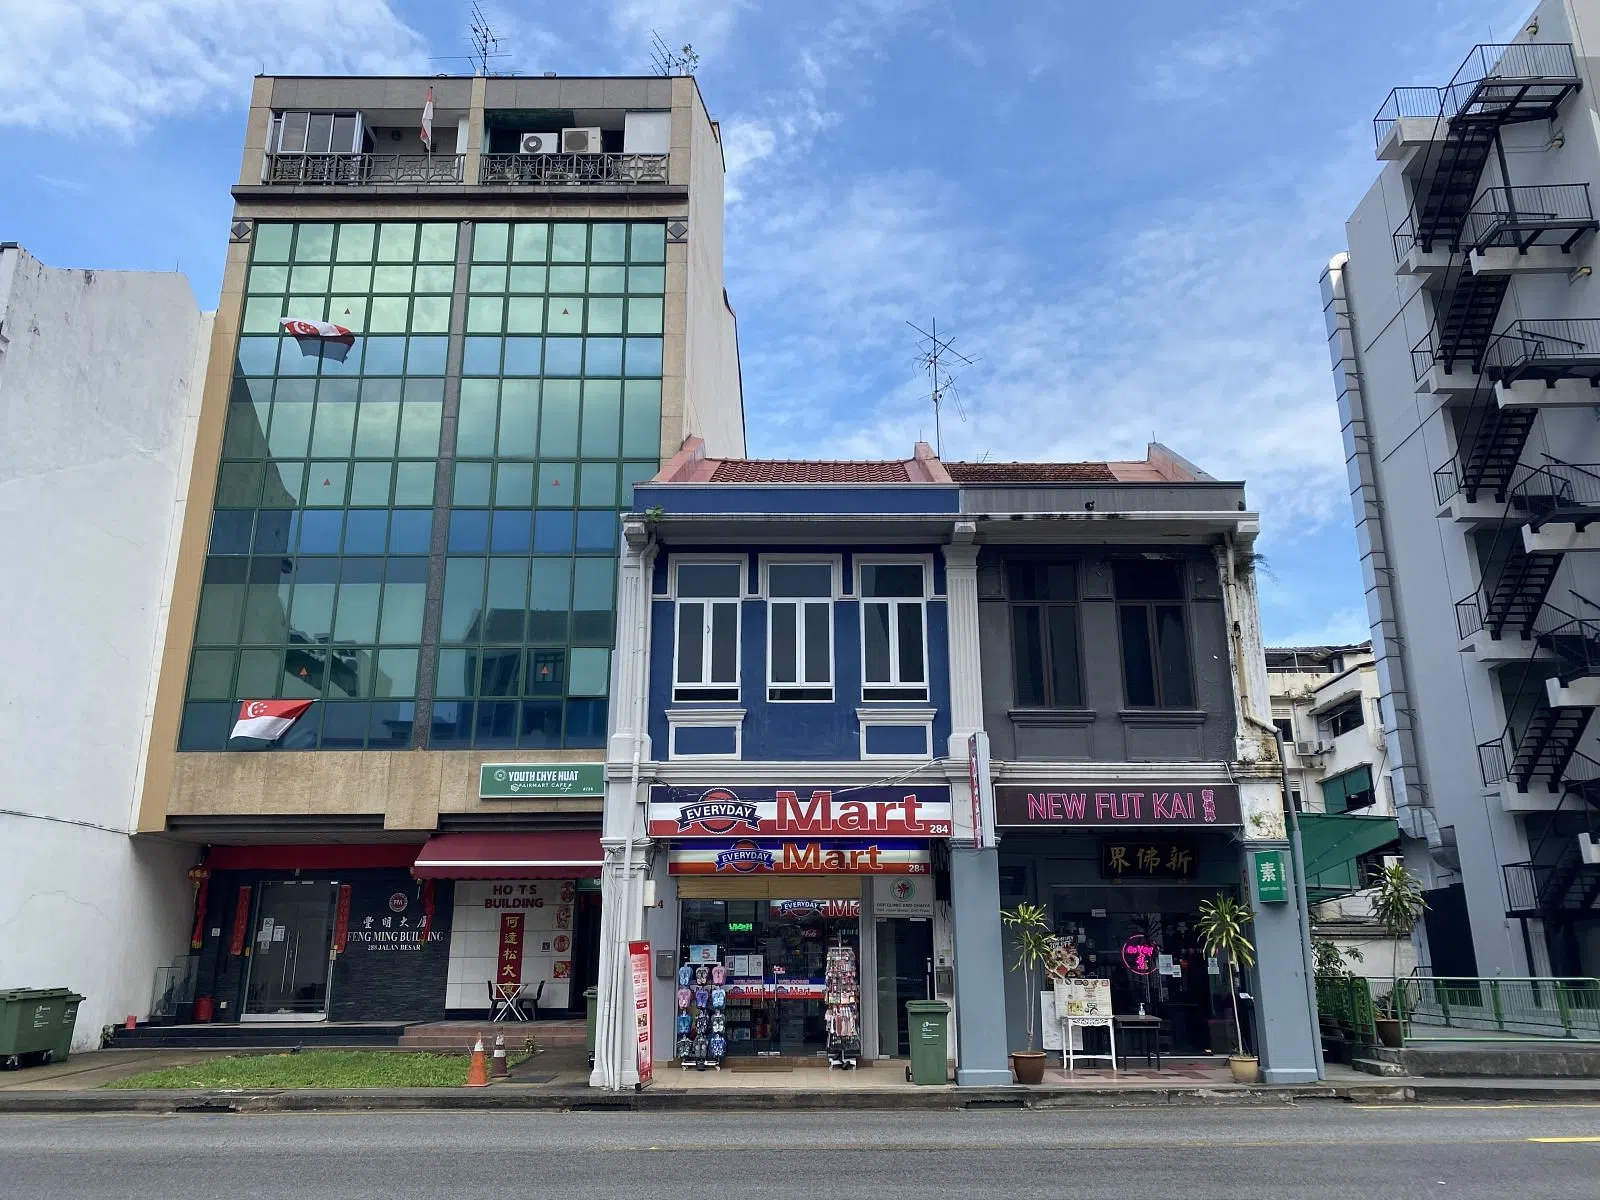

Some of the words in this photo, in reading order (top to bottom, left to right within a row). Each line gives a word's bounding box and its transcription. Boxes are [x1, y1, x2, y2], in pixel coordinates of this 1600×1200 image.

[508, 771, 537, 782] YOUTH
[537, 771, 557, 782] CHYE
[558, 770, 579, 781] HUAT
[685, 803, 752, 819] EVERYDAY
[775, 790, 925, 831] Mart
[1026, 793, 1087, 820] NEW
[1095, 792, 1145, 819] FUT
[1152, 792, 1196, 819] KAI
[929, 824, 949, 834] 284
[721, 851, 770, 863] EVERYDAY
[782, 842, 884, 870] Mart
[908, 864, 925, 873] 284
[1260, 861, 1277, 882] 素
[492, 884, 513, 895] HO
[484, 898, 544, 909] BUILDING
[784, 901, 819, 910] EVERYDAY
[347, 931, 372, 942] FENG
[373, 931, 398, 942] MING
[400, 931, 444, 942] BUILING
[789, 986, 811, 996] Mart
